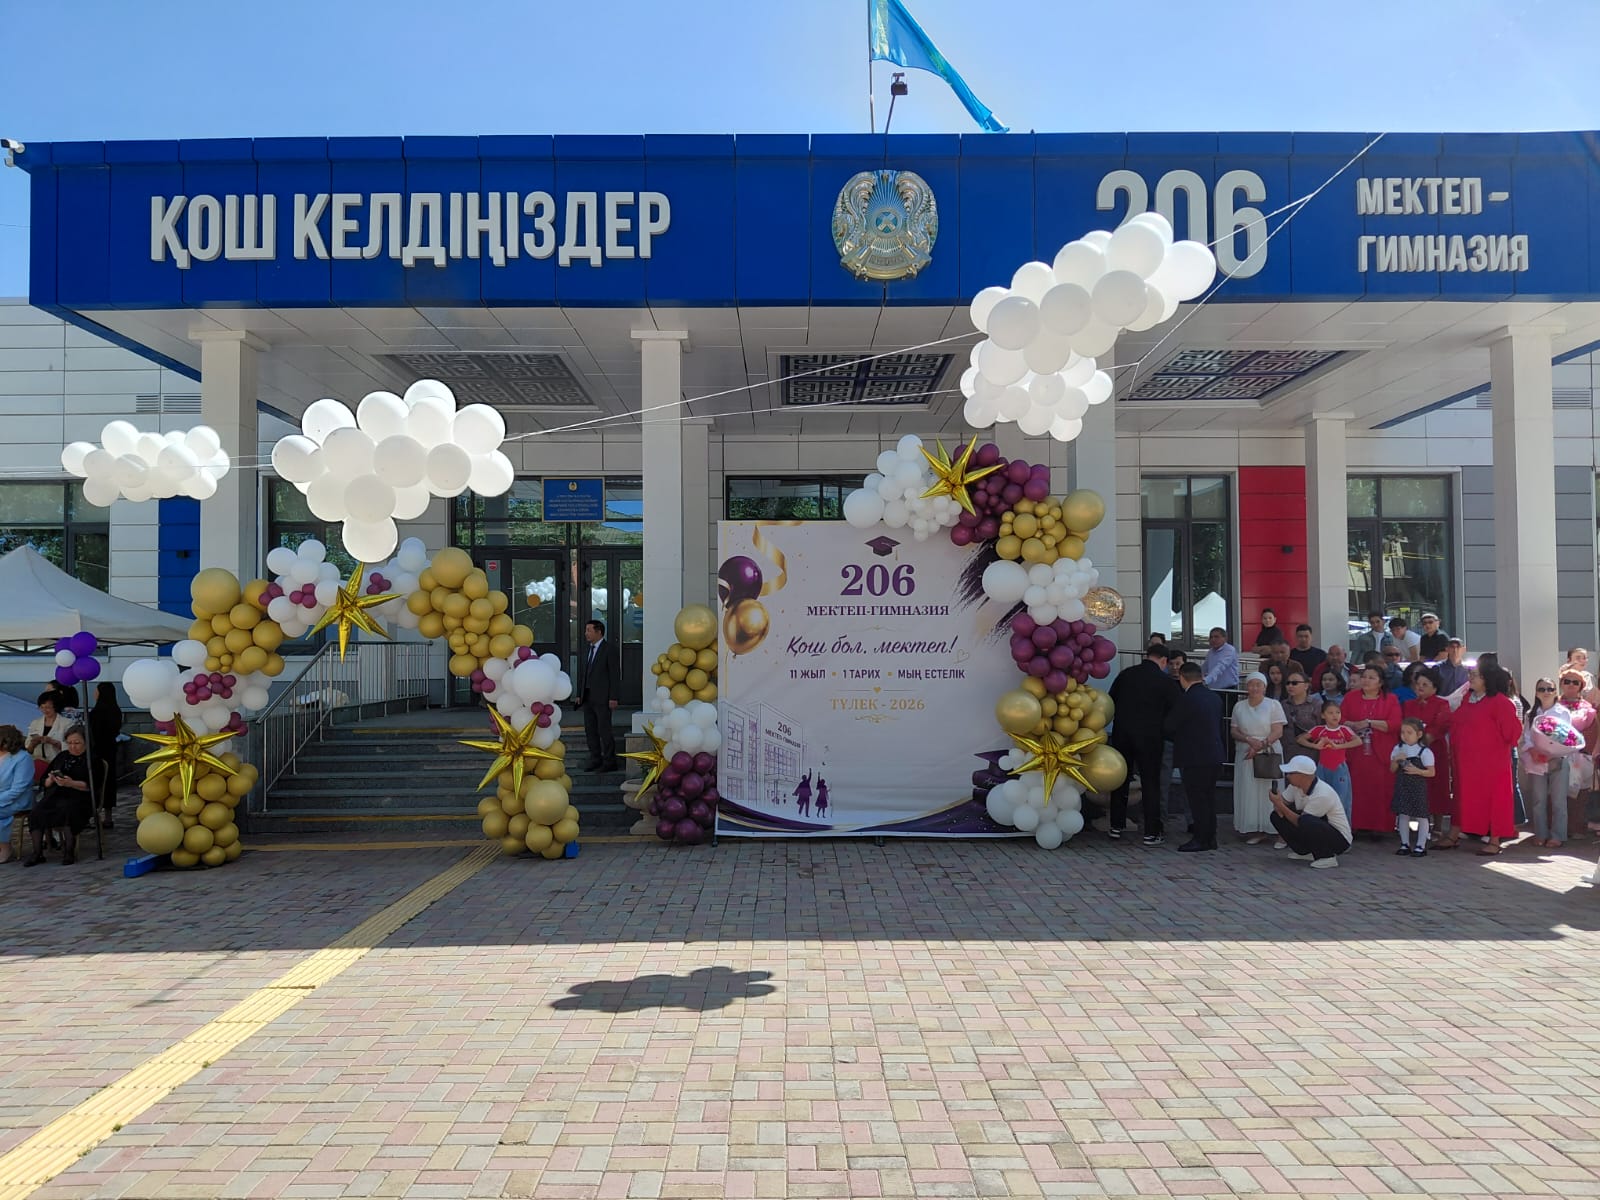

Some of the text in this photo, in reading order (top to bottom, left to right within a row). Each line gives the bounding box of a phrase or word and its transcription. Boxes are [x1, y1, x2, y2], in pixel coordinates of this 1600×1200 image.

[1356, 177, 1482, 215] МЕКТЕП
[150, 190, 672, 270] ҚОШ КЕЛДІҢІЗДЕР
[1096, 169, 1268, 279] 206
[1357, 234, 1529, 273] ГИМНАЗИЯ
[840, 564, 916, 597] 206
[806, 604, 950, 617] МЕКТЕП-ГИМНАЗИЯ
[873, 635, 959, 655] мектеп!
[789, 669, 966, 682] 11 ЖЫЛ 1 ТАРИХ МЫҢ ЕСТЕЛІК
[889, 698, 926, 711] 2026
[777, 721, 793, 737] 206
